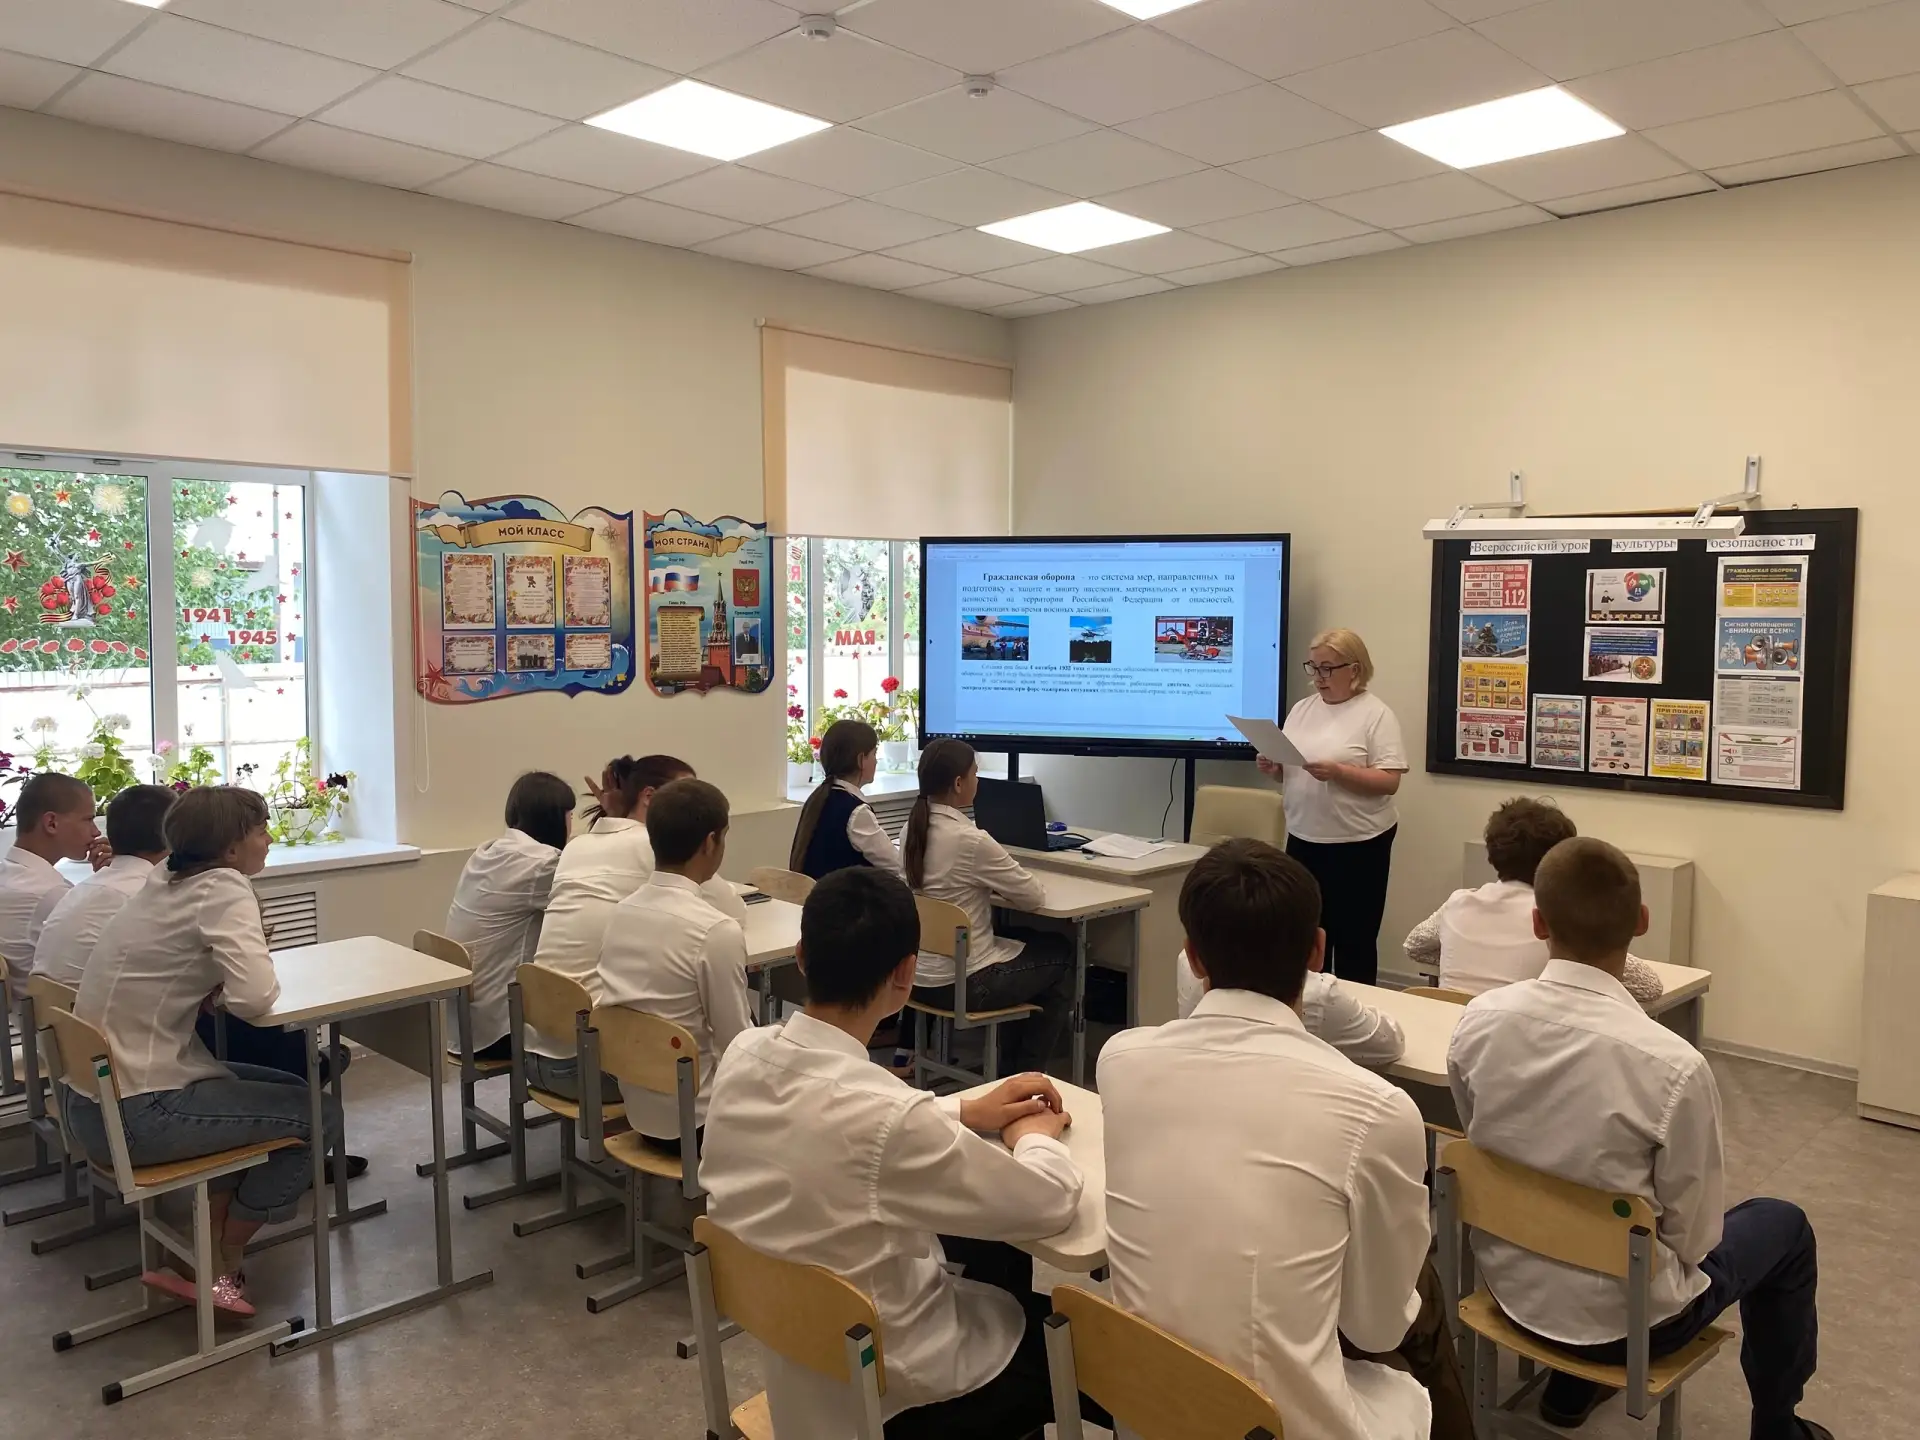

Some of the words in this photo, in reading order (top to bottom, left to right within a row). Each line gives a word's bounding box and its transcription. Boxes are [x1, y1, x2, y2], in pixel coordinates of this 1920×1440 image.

[498, 525, 524, 537] МОЙ
[527, 526, 565, 539] КЛАСС
[654, 537, 675, 547] МОЯ
[676, 538, 711, 550] СТРАНА
[1474, 541, 1558, 554] Всероссийский
[1560, 542, 1588, 554] урок
[1615, 539, 1674, 551] культуры
[983, 572, 1039, 582] Гражданская
[1040, 572, 1076, 582] оборона
[1136, 574, 1156, 583] мер,
[1157, 574, 1219, 583] направленных
[1190, 587, 1235, 595] культурных
[1504, 589, 1526, 606] 112
[1023, 596, 1064, 604] территории
[1071, 596, 1114, 604] Российской
[1122, 596, 1163, 605] Федерации
[1188, 596, 1235, 604] опасностей,
[182, 608, 232, 623] 1941
[227, 630, 278, 645] 1945
[835, 630, 876, 646] МАЯ
